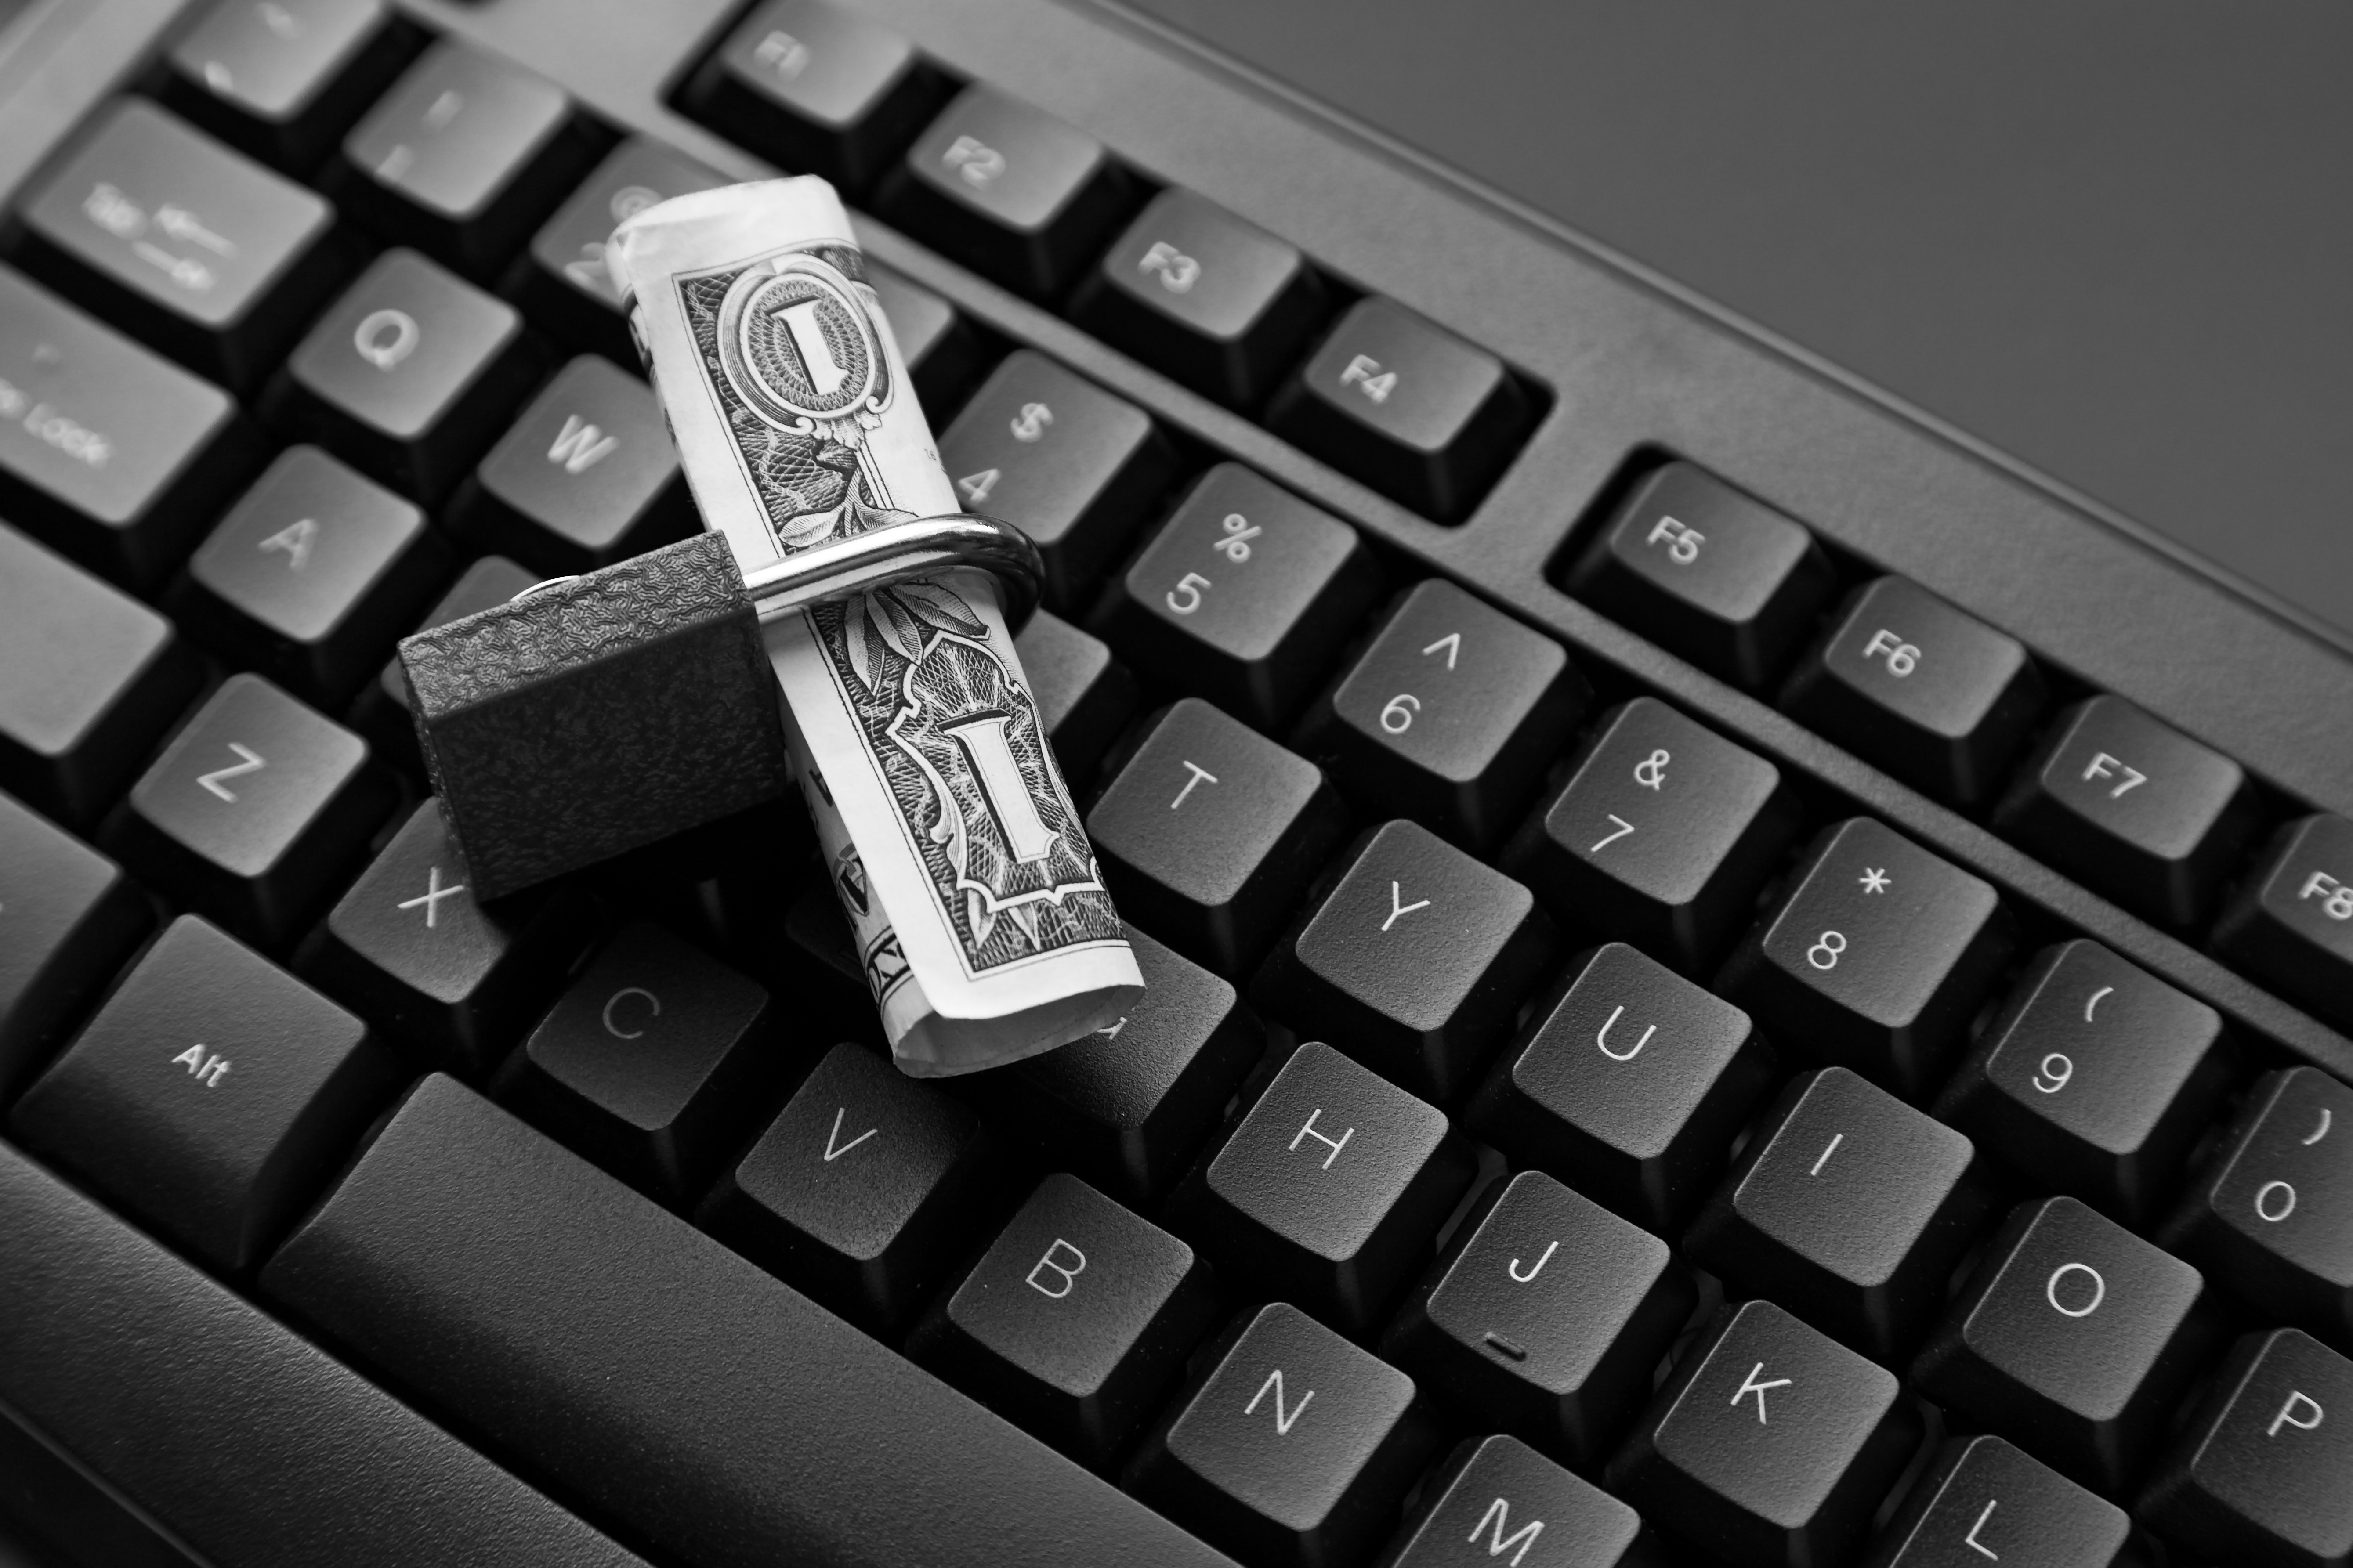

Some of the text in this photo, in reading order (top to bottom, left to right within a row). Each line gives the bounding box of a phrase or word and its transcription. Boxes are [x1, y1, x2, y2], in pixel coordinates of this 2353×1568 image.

[942, 135, 1005, 186] F2
[1140, 242, 1199, 289] F3
[354, 309, 419, 370] Q
[771, 295, 849, 395] 1
[1341, 355, 1396, 402] F4
[547, 413, 617, 474] W
[1011, 403, 1052, 440] $
[958, 468, 1000, 502] 4
[259, 519, 315, 566] A
[1214, 514, 1260, 562] %
[1648, 516, 1705, 563] F5
[1167, 572, 1210, 614] 5
[1864, 629, 1921, 676] F6
[1381, 694, 1420, 733] 6
[197, 744, 263, 801] Z
[943, 714, 1060, 863] 1
[1171, 761, 1217, 809] T
[1634, 749, 1670, 790] &
[2083, 753, 2146, 797] F7
[1591, 814, 1634, 852] 7
[398, 867, 463, 927] X
[1382, 881, 1430, 931] Y
[2300, 872, 2353, 919] F8
[1807, 931, 1846, 969] 8
[603, 987, 660, 1039] C
[2085, 987, 2114, 1022] (
[1597, 1006, 1656, 1060] U
[172, 1044, 228, 1087] Alt
[2033, 1053, 2073, 1093] 9
[824, 1108, 877, 1161] V
[1289, 1109, 1354, 1169] H
[2303, 1109, 2331, 1145] )
[1810, 1134, 1843, 1175] I
[1026, 1239, 1086, 1298] B
[1509, 1241, 1559, 1282] J
[2047, 1263, 2104, 1317] O
[1245, 1370, 1314, 1434] N
[1731, 1362, 1792, 1423] K
[2268, 1391, 2323, 1436] P
[1468, 1498, 1544, 1567] M
[1966, 1500, 1998, 1560] L
